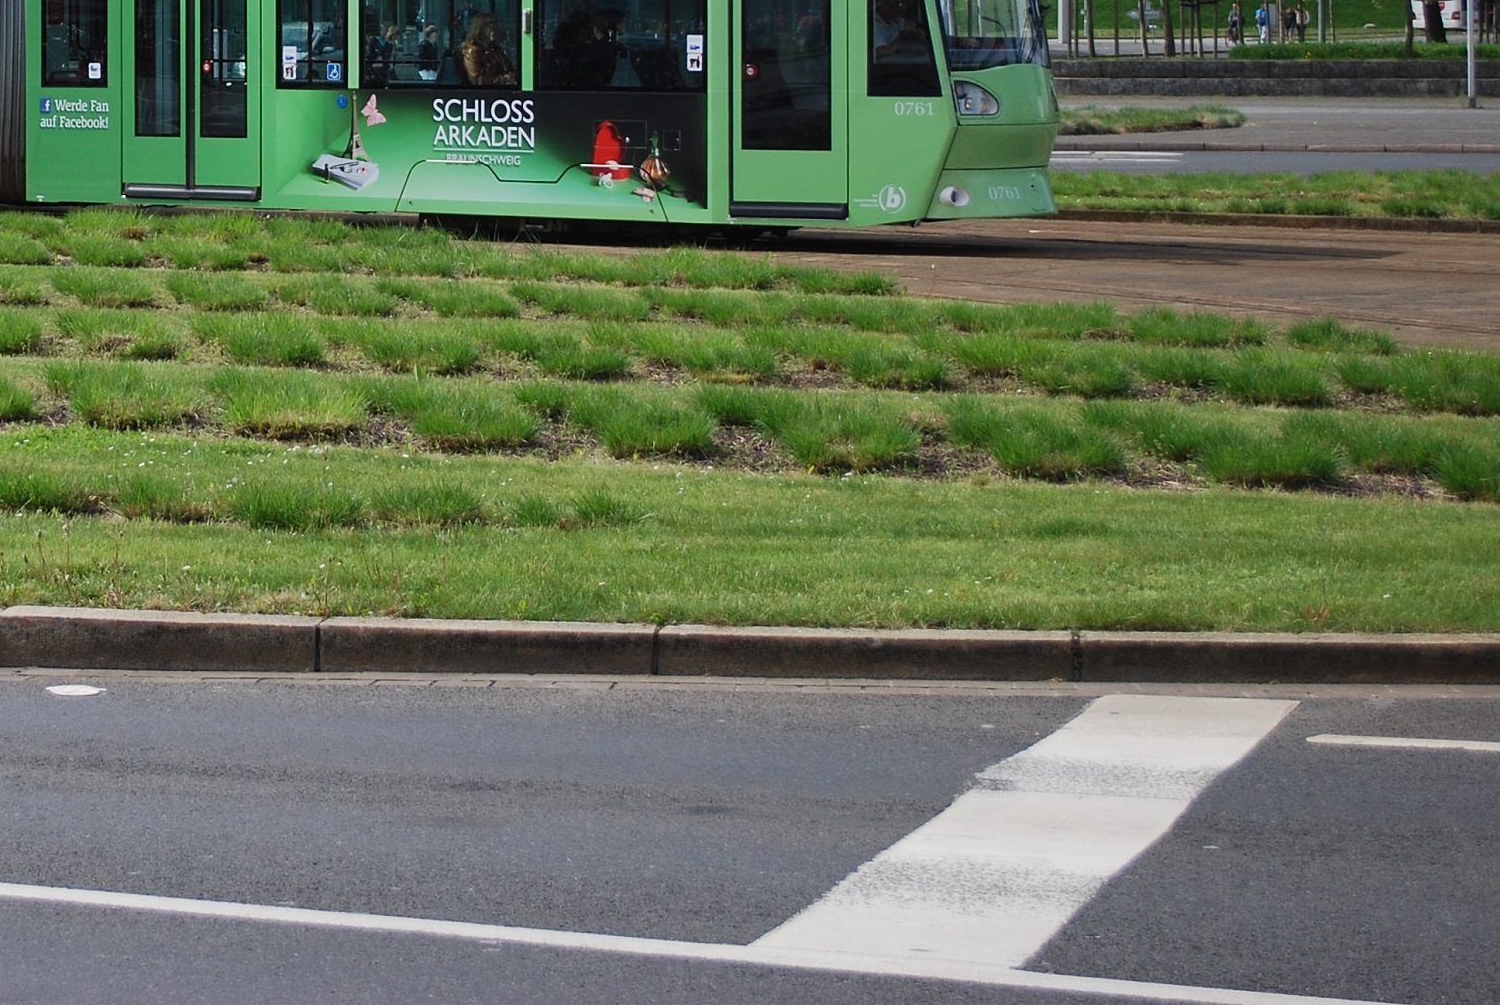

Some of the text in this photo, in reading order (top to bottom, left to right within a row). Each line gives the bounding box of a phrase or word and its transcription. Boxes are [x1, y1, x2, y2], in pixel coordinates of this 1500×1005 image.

[54, 99, 88, 112] Werde
[91, 99, 109, 112] Fan
[432, 97, 535, 123] SCHLOSS
[894, 101, 935, 117] 0761
[40, 115, 109, 129] auf Facebook!
[433, 124, 535, 148] ARKADEN
[445, 153, 521, 166] BRAUNSCHWEIG
[988, 186, 1021, 201] 0761
